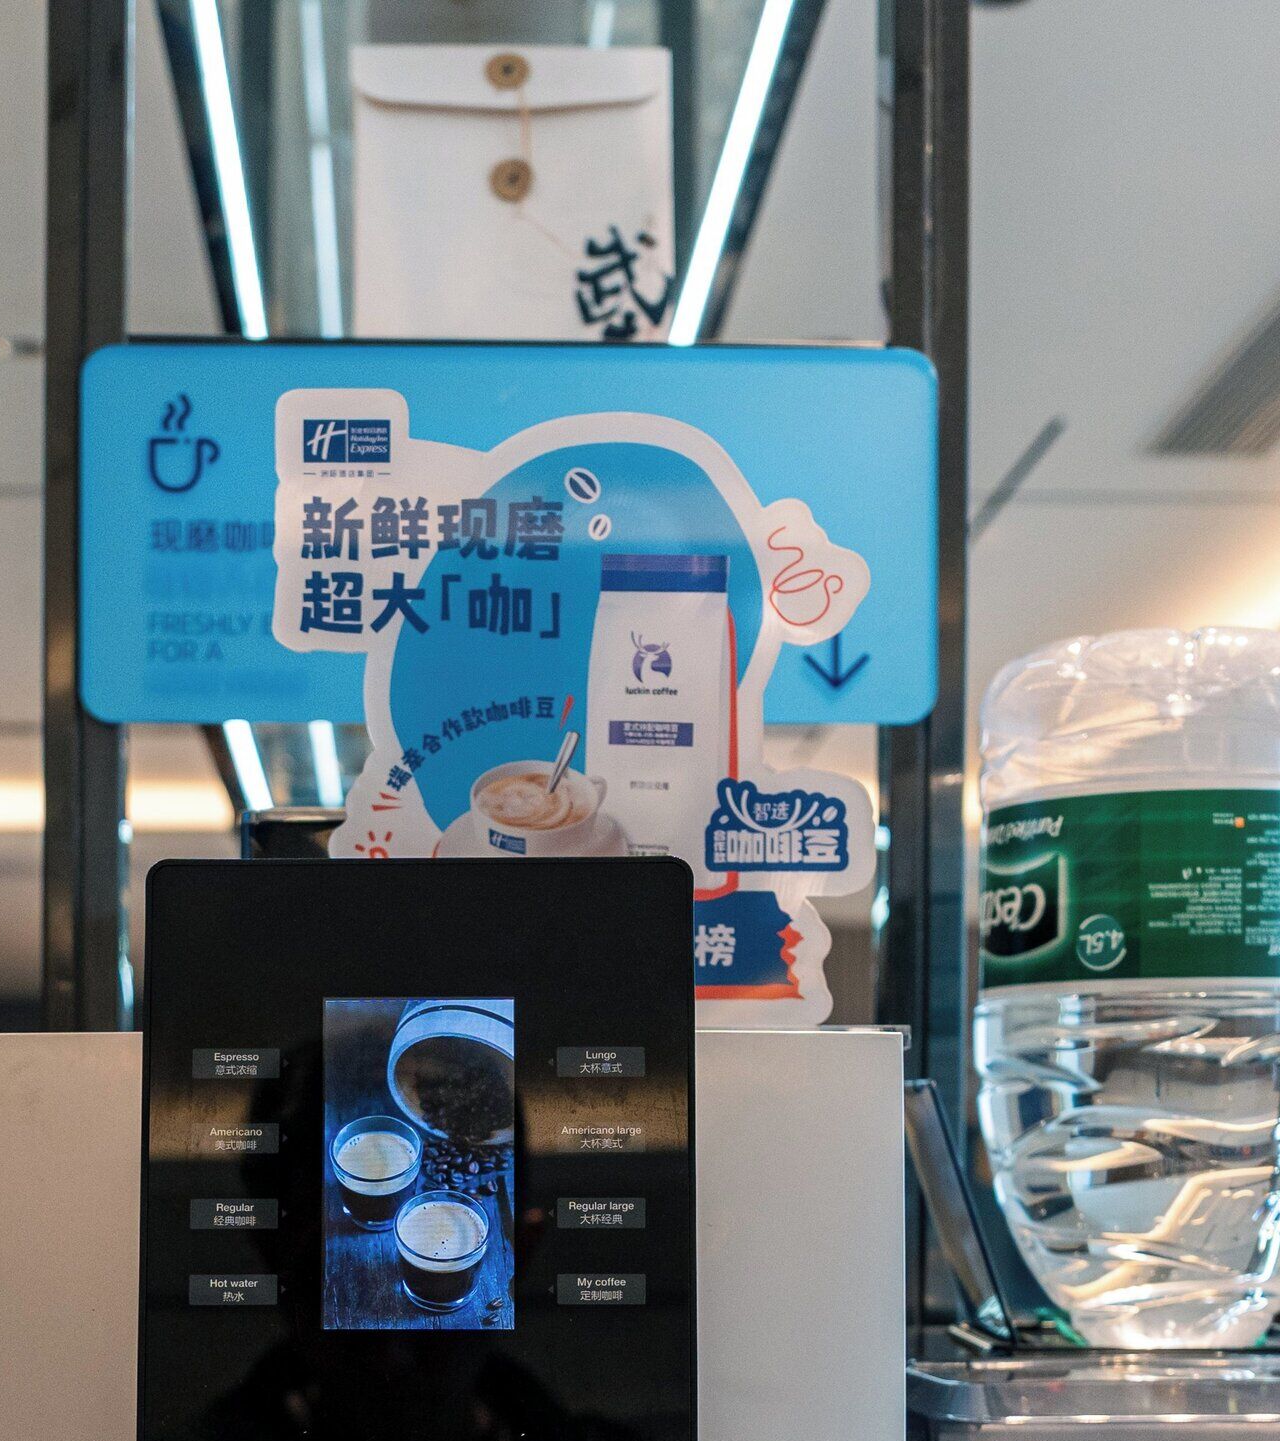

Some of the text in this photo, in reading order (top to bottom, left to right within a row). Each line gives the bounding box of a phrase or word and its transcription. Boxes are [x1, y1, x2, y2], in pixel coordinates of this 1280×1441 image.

[350, 443, 388, 455] Express
[301, 496, 565, 561] 新鲜现磨
[300, 571, 560, 639] 超大「咖」
[625, 687, 678, 696] luckin coffee
[753, 801, 790, 821] 智选
[727, 829, 841, 863] 咖啡豆
[694, 924, 736, 967] 榜
[1078, 929, 1124, 955] 4.5L
[213, 1052, 260, 1064] Espresso
[585, 1049, 617, 1062] Lungo
[215, 1064, 258, 1076] 意式浓缩
[579, 1062, 623, 1074] 大杯意式
[209, 1126, 263, 1138] Americano
[561, 1125, 642, 1137] Americano large
[214, 1139, 258, 1151] 美式咖啡
[579, 1138, 624, 1149] 大杯美式
[215, 1202, 254, 1215] Regular
[568, 1200, 635, 1213] Regular large
[213, 1214, 257, 1226] 经典咖啡
[579, 1213, 624, 1225] 大杯经典
[209, 1278, 258, 1289] Hot water
[576, 1276, 627, 1290] My coffee
[222, 1290, 245, 1302] 热水
[579, 1289, 624, 1301] 定制咖啡
